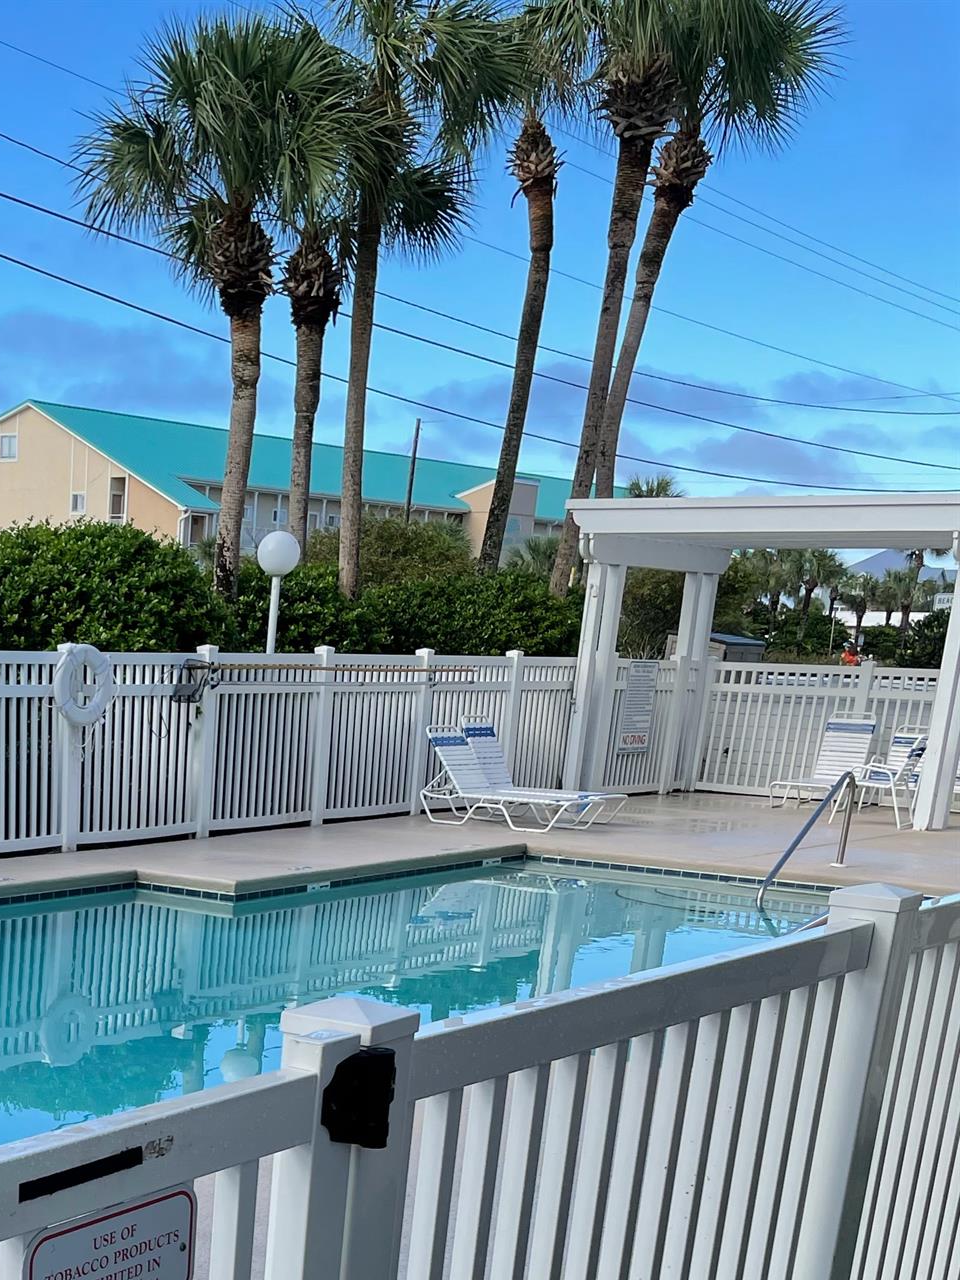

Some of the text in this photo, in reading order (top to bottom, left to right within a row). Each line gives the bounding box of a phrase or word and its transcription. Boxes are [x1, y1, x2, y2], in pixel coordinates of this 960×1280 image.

[622, 734, 646, 745] NO DIVING
[93, 1224, 137, 1250] USE OF
[114, 1229, 180, 1265] PRODUCTS
[147, 1256, 161, 1273] IN
